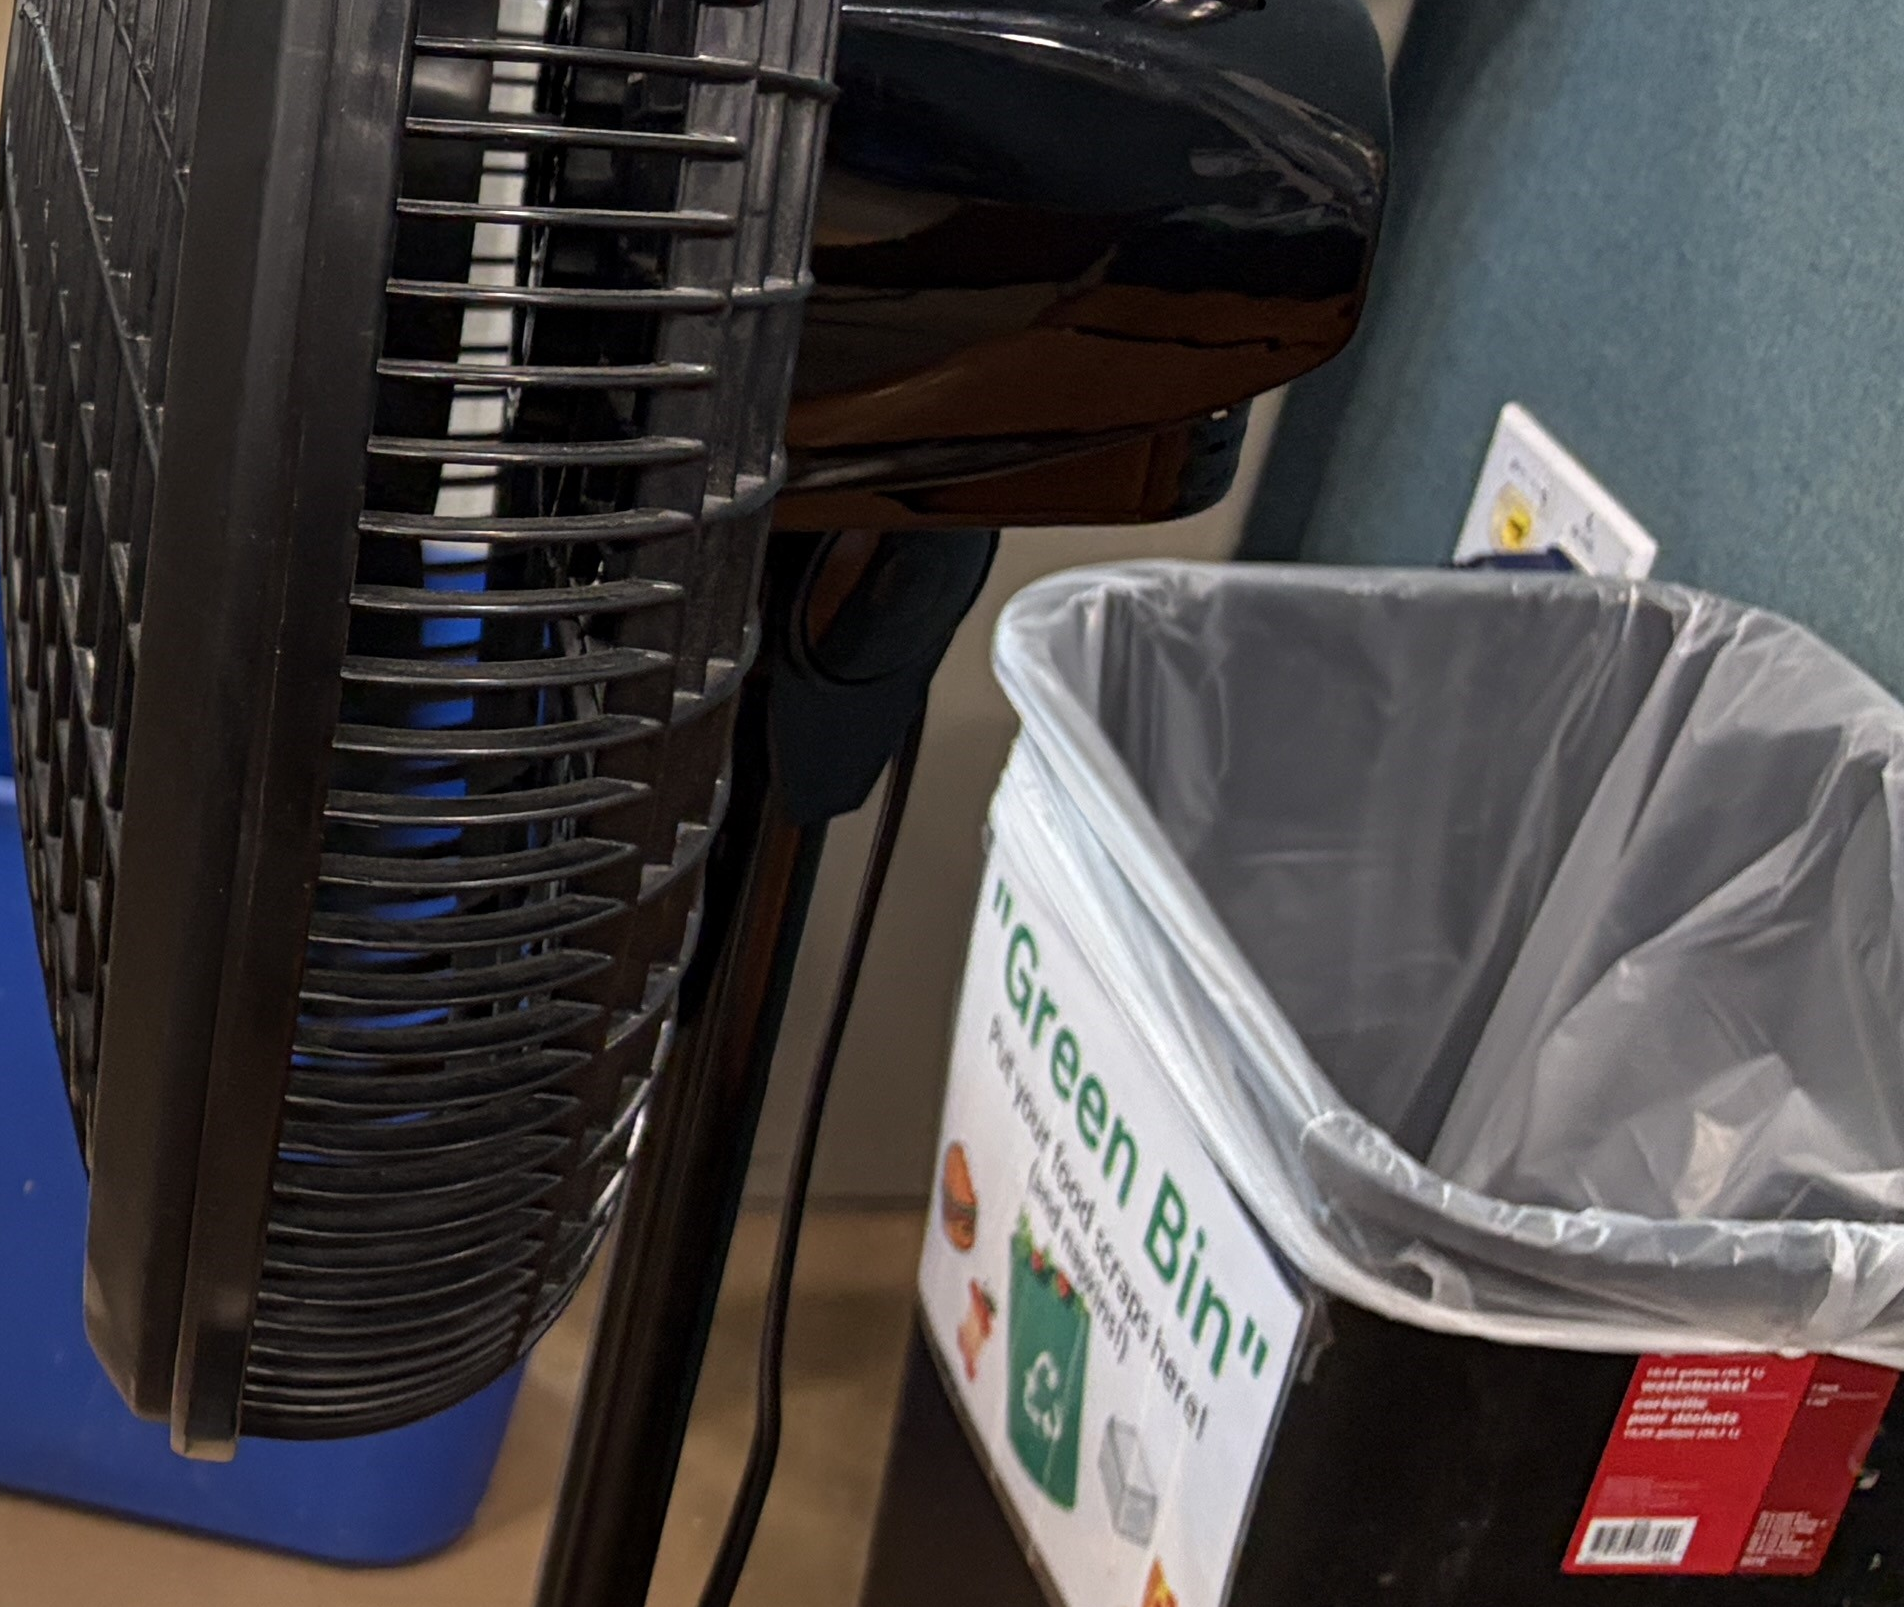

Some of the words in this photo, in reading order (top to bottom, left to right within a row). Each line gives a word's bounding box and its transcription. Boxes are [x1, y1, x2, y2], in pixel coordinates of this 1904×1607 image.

[993, 880, 1139, 1209] "Green
[1143, 1170, 1269, 1380] Bin"
[1012, 1076, 1050, 1152] your
[1051, 1138, 1097, 1238] food
[1092, 1224, 1152, 1344] scraps
[1150, 1324, 1208, 1444] here!
